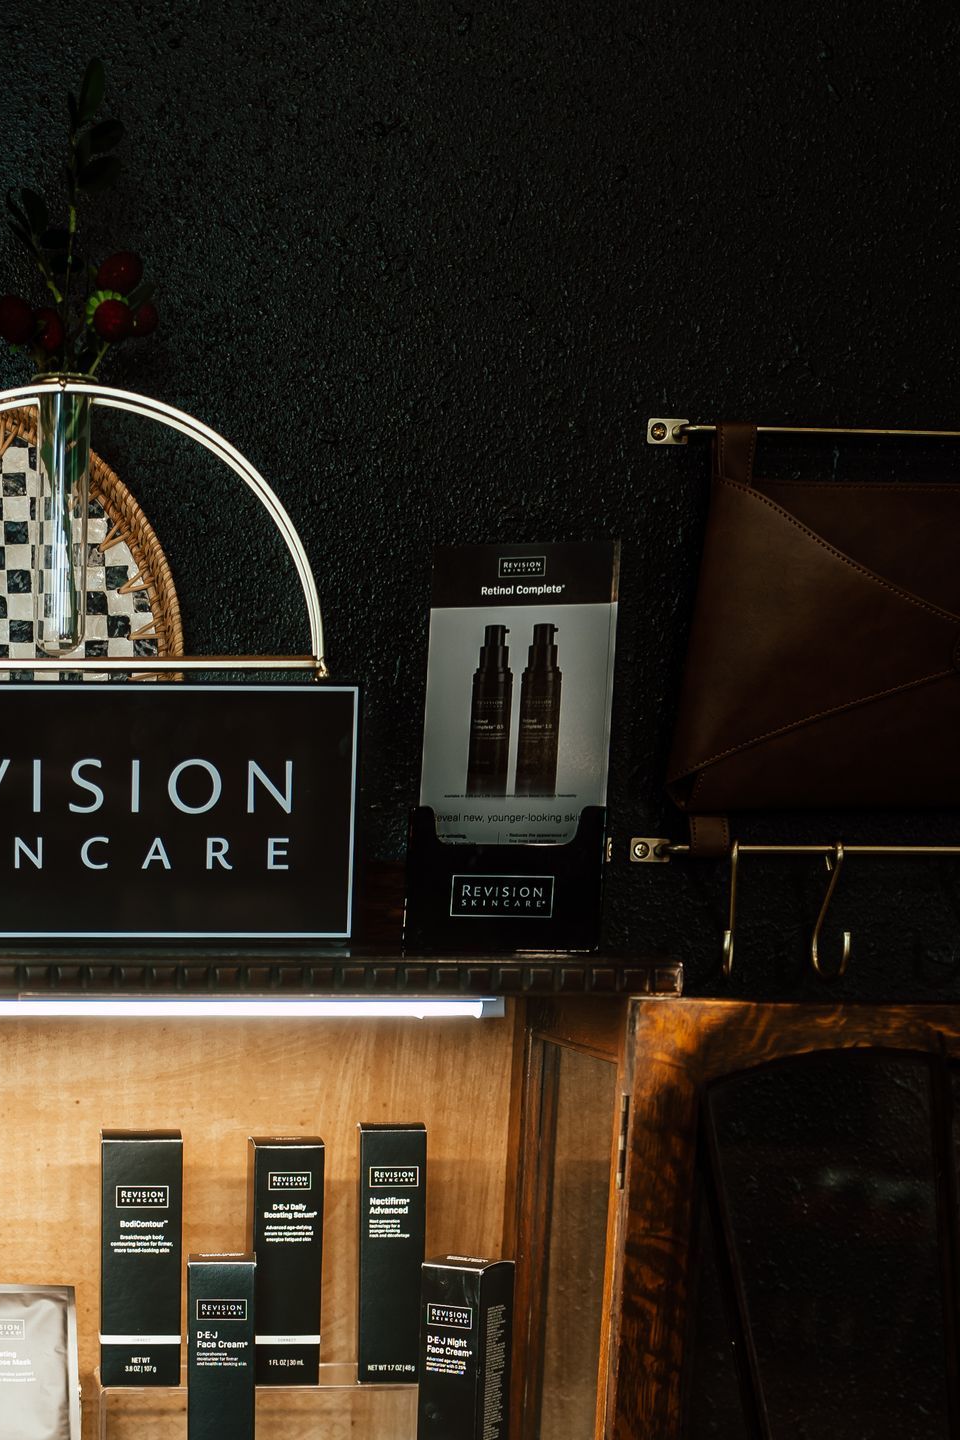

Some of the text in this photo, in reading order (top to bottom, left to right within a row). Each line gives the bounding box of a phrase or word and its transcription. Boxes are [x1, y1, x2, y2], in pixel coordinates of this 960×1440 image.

[481, 585, 514, 596] Retinol
[463, 814, 485, 823] new,
[488, 813, 562, 824] younger-looking
[462, 885, 543, 897] REVISION
[370, 1206, 408, 1214] Advanced
[432, 1309, 468, 1319] REVISION
[447, 1338, 467, 1348] Night
[427, 1345, 444, 1354] Face
[12, 1358, 31, 1366] Mask
